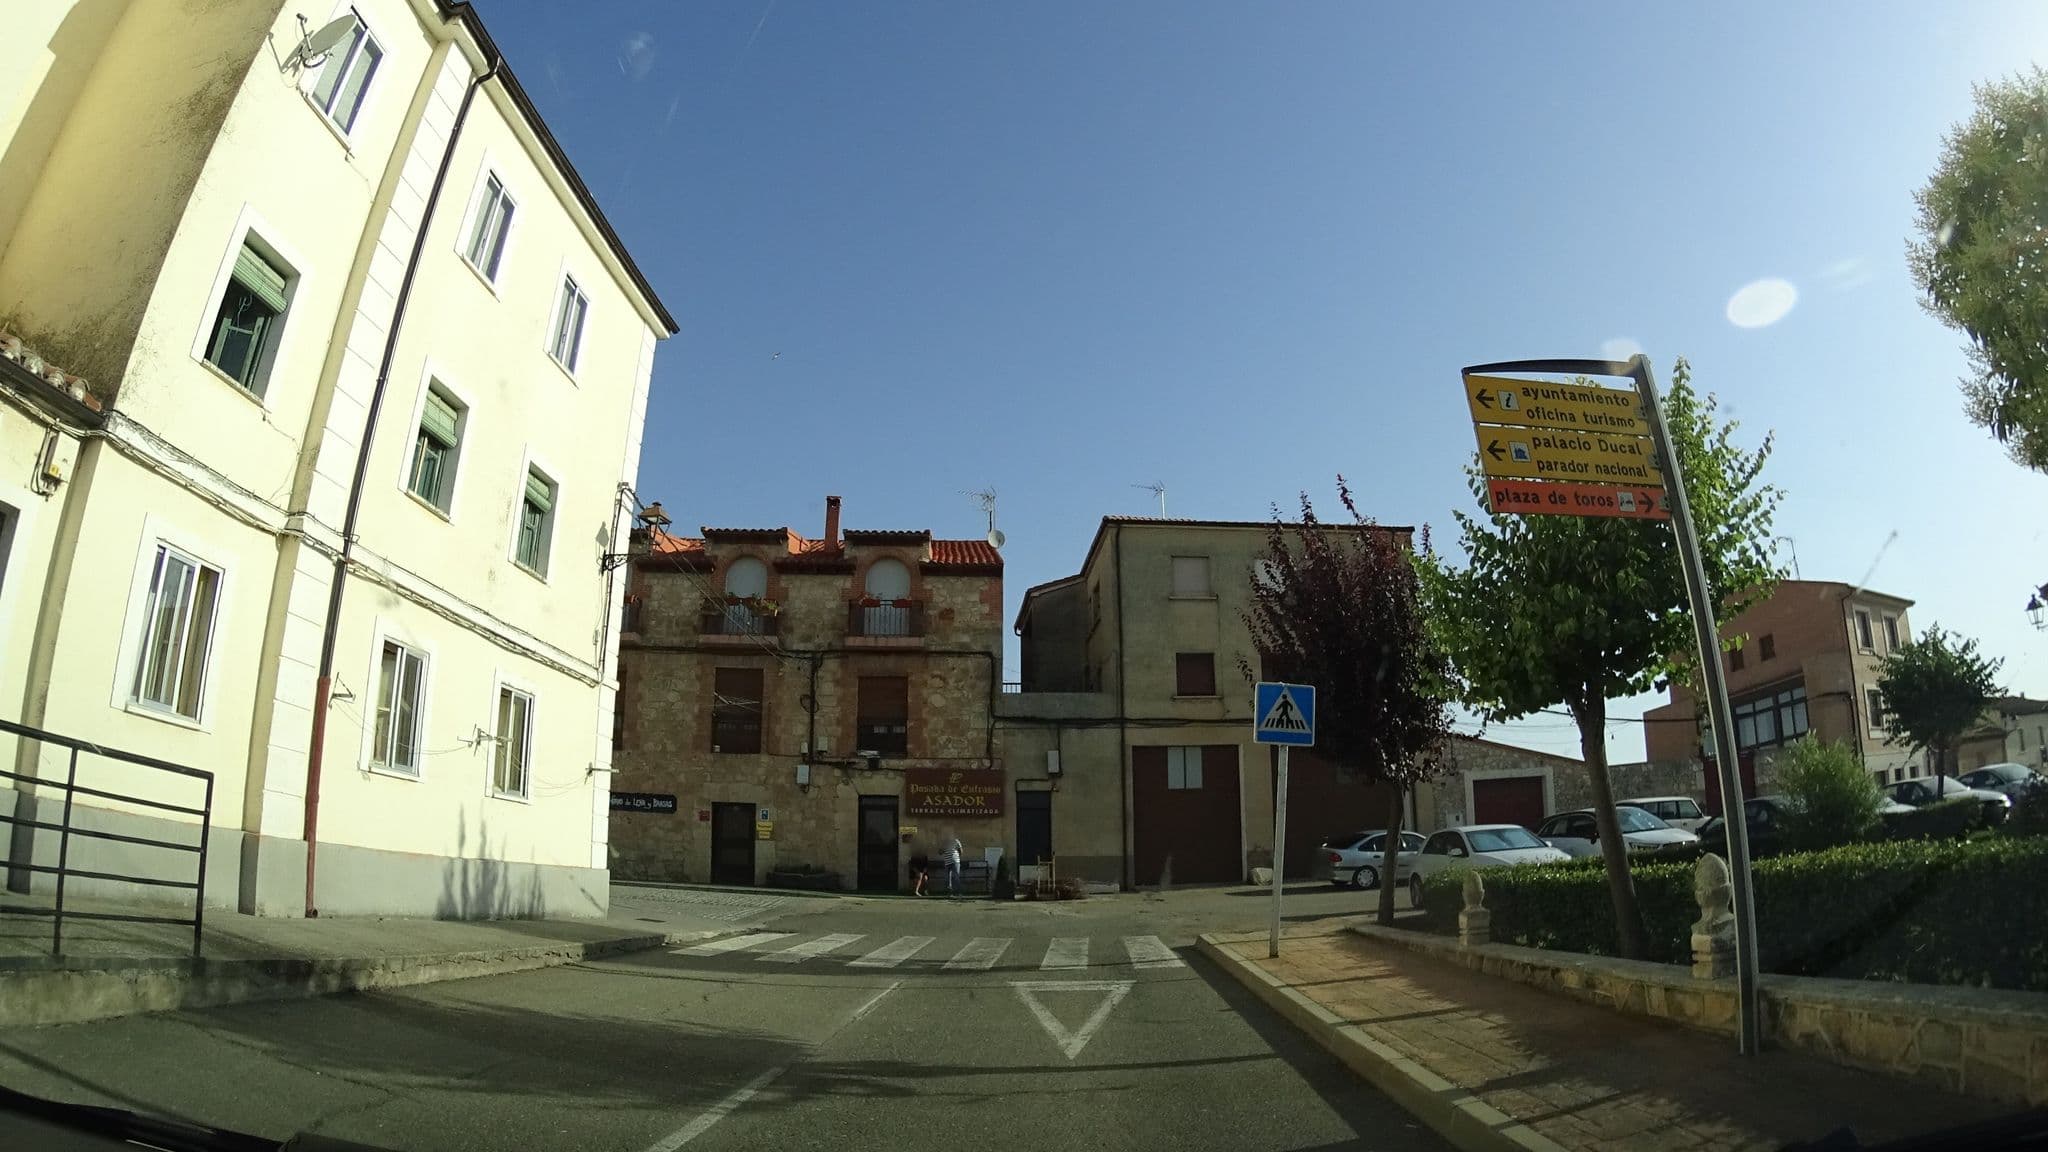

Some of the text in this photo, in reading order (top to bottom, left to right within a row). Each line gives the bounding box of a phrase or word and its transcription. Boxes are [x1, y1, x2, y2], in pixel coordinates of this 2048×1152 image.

[1522, 385, 1630, 407] ayuntamiento
[1526, 407, 1635, 428] oficina turismo
[1532, 435, 1642, 456] palacio Ducal
[1536, 459, 1648, 478] parador nacional
[1495, 489, 1614, 507] plaza de toros
[947, 784, 957, 793] de
[923, 795, 985, 806] ASADOR
